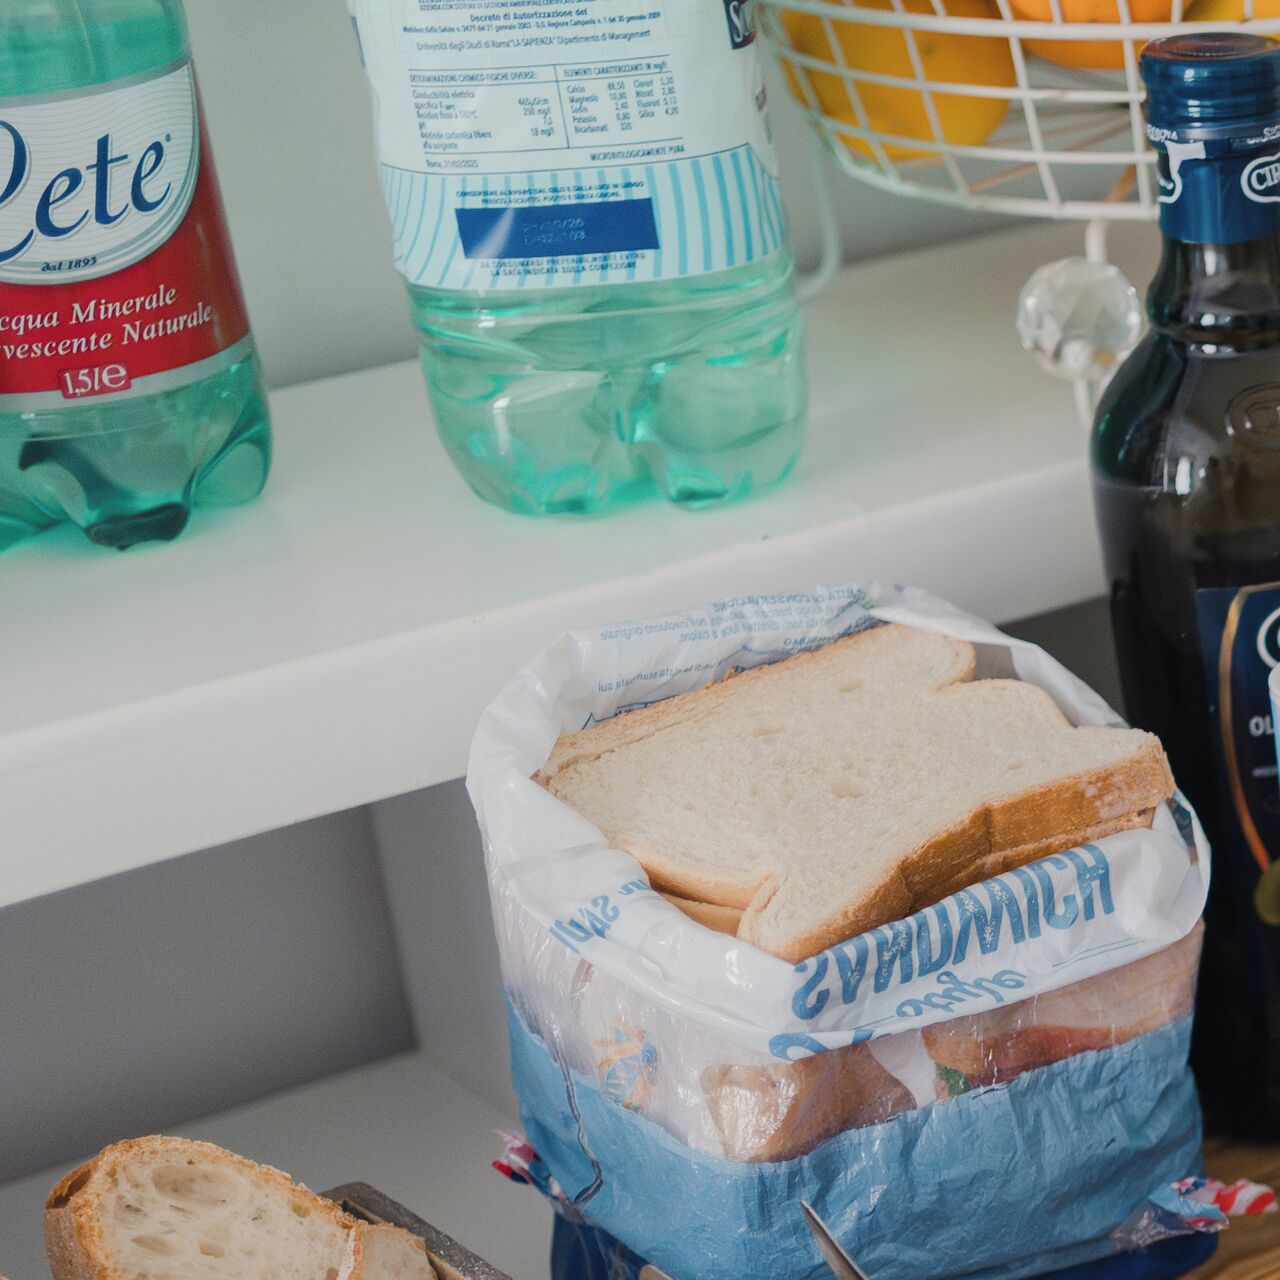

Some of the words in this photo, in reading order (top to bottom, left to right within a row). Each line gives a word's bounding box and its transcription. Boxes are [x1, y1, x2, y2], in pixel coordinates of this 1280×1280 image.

[67, 256, 98, 270] 1893
[69, 284, 178, 326] Minerale
[0, 330, 113, 361] vescente
[121, 302, 213, 345] Naturale
